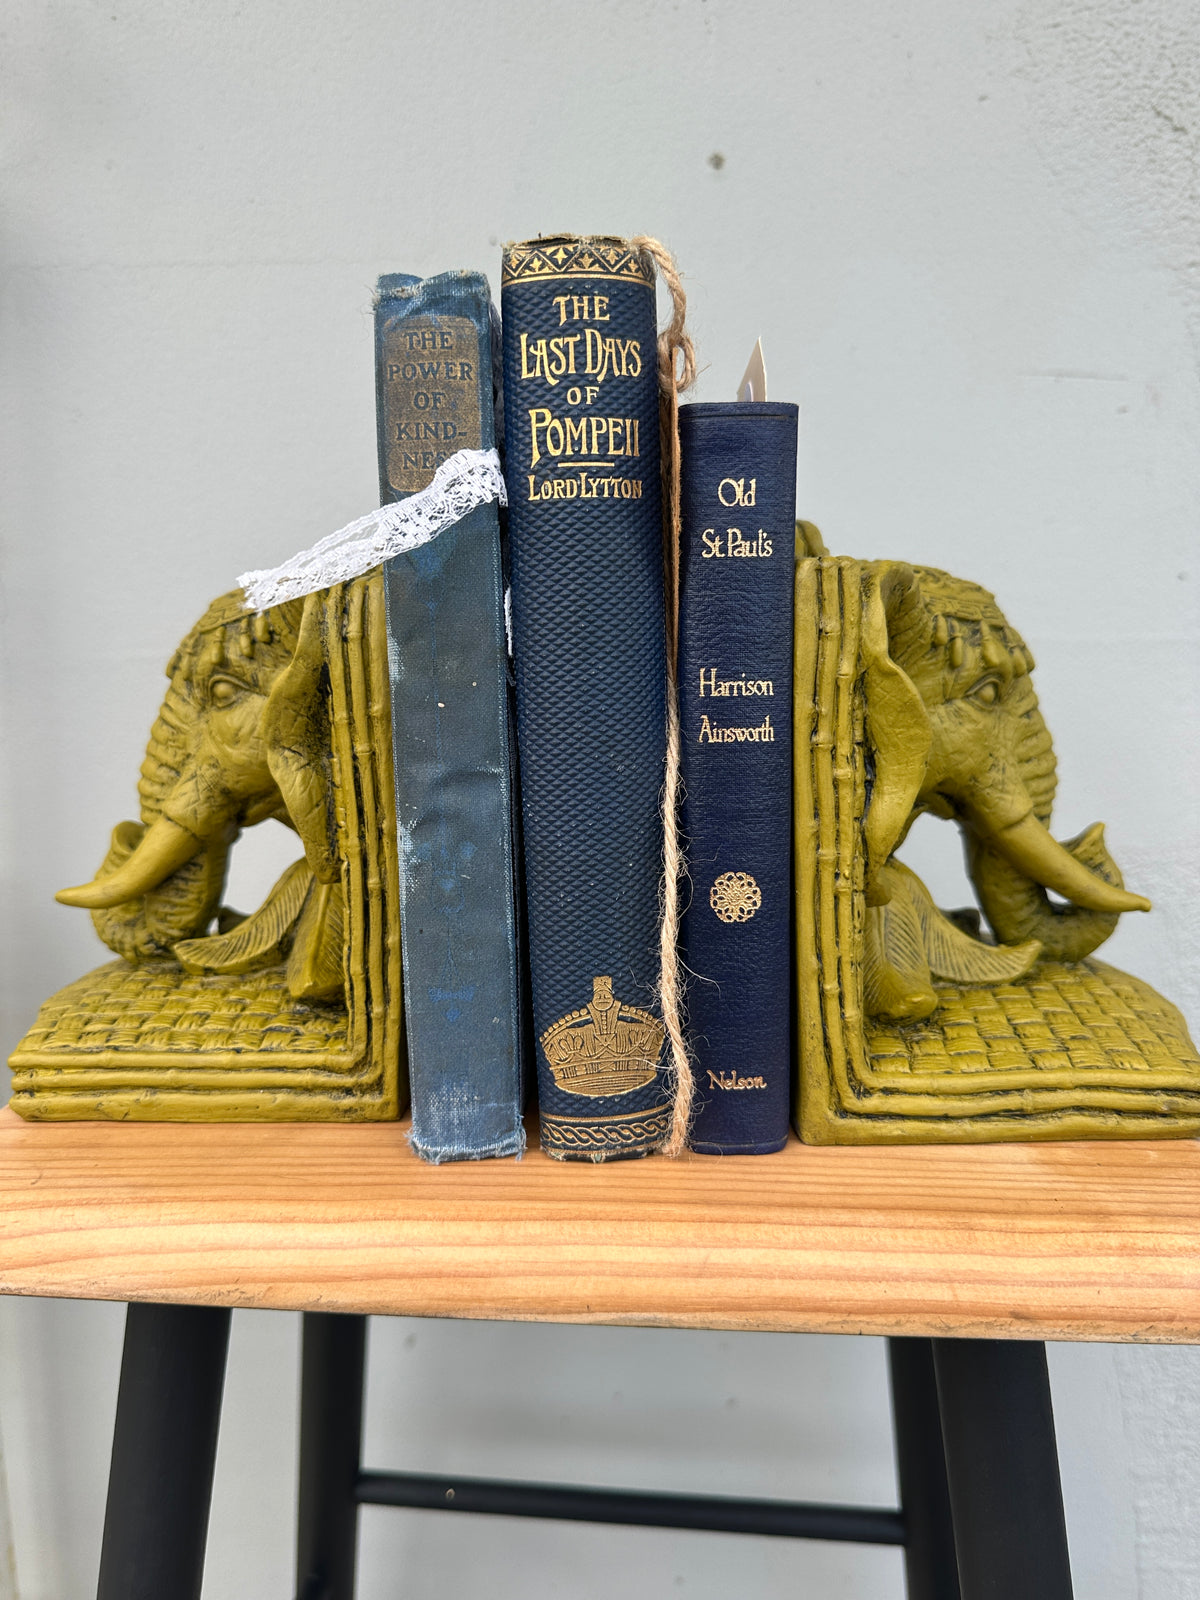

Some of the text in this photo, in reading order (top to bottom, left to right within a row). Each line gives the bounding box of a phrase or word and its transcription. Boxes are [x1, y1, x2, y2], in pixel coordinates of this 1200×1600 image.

[552, 295, 611, 327] THE
[403, 331, 453, 351] THE
[387, 361, 474, 381] POWER
[519, 328, 642, 386] LAST DAYS
[412, 391, 445, 411] OF
[566, 386, 600, 406] OF
[395, 421, 468, 442] KIND-
[528, 408, 640, 469] POMPEII
[402, 451, 458, 471] NES
[527, 472, 643, 501] LORD LYTTON
[717, 477, 757, 507] Old
[726, 527, 773, 557] Paul's
[699, 667, 774, 697] Harrison
[697, 714, 775, 743] Ainsworth
[706, 1069, 768, 1091] Nelson
